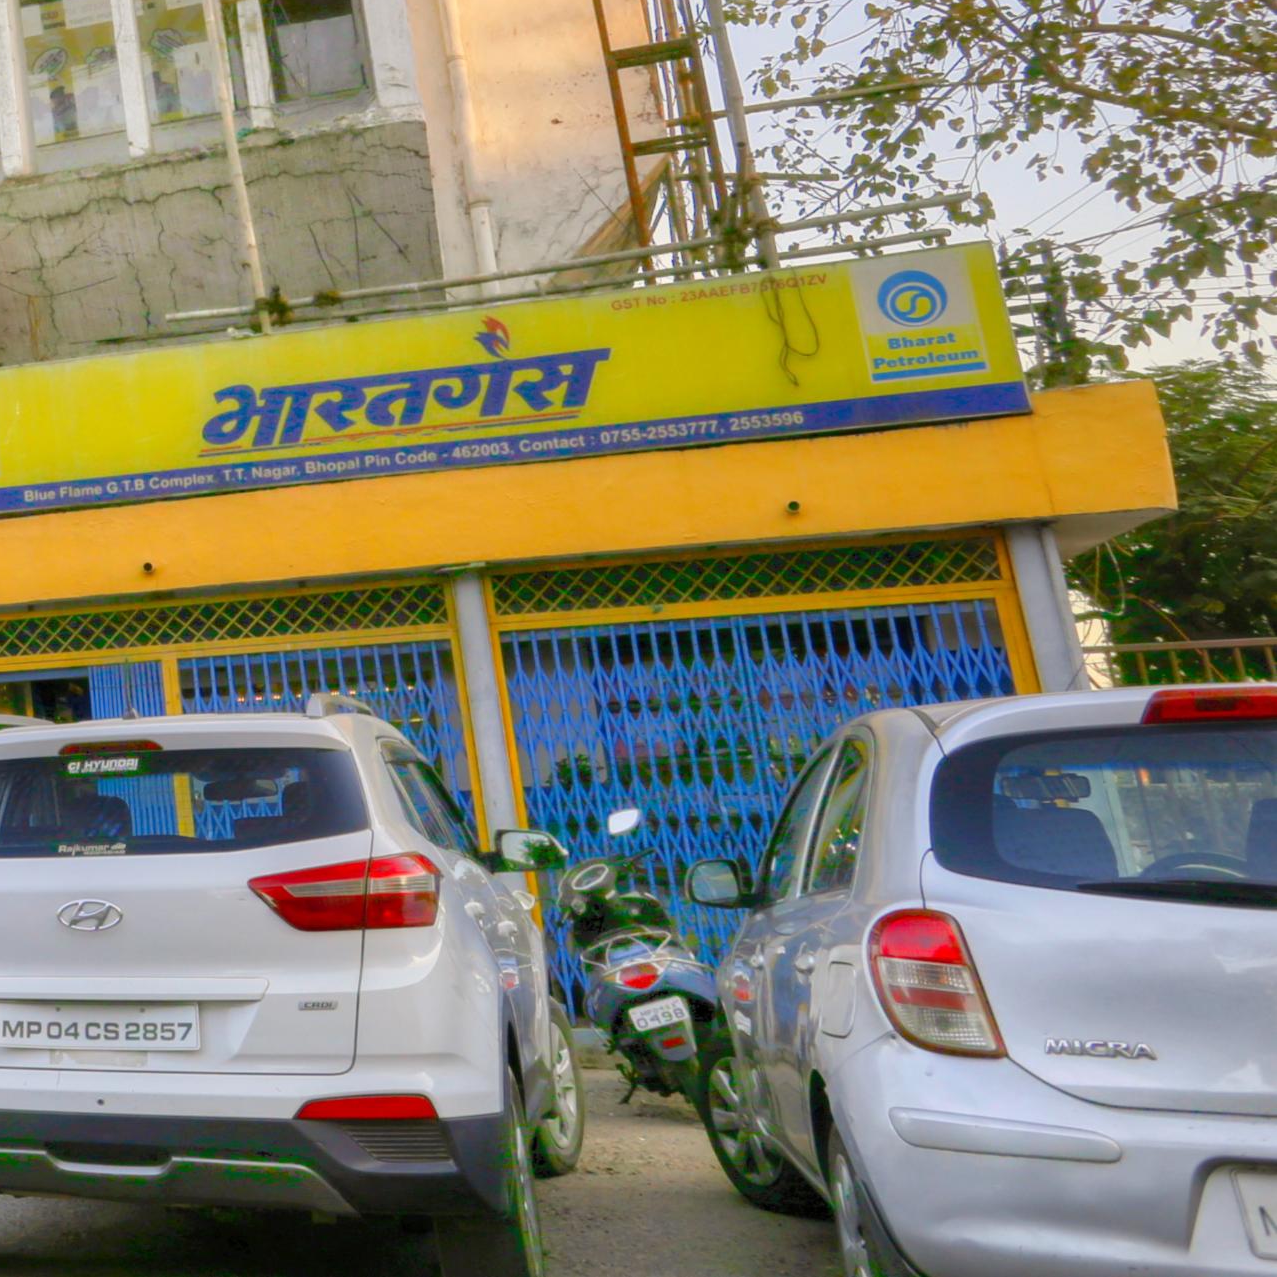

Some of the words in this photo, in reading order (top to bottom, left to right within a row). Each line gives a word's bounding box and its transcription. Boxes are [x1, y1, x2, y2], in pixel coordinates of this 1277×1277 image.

[611, 298, 641, 312] GST
[647, 295, 667, 306] No
[887, 331, 957, 352] Bharat
[872, 347, 979, 370] Petroleum
[24, 489, 56, 503] Blue
[59, 484, 102, 499] Flame
[106, 479, 145, 494] G.T.B
[305, 456, 360, 476] Bhopal
[365, 453, 391, 468] Pin
[395, 449, 437, 465] Code
[519, 435, 585, 453] Contact
[729, 410, 804, 432] 2553596
[2, 1020, 42, 1040] MP
[46, 1022, 80, 1040] 04
[85, 1023, 120, 1041] CS
[125, 1023, 193, 1042] 2857
[1045, 1038, 1158, 1061] MICRA
